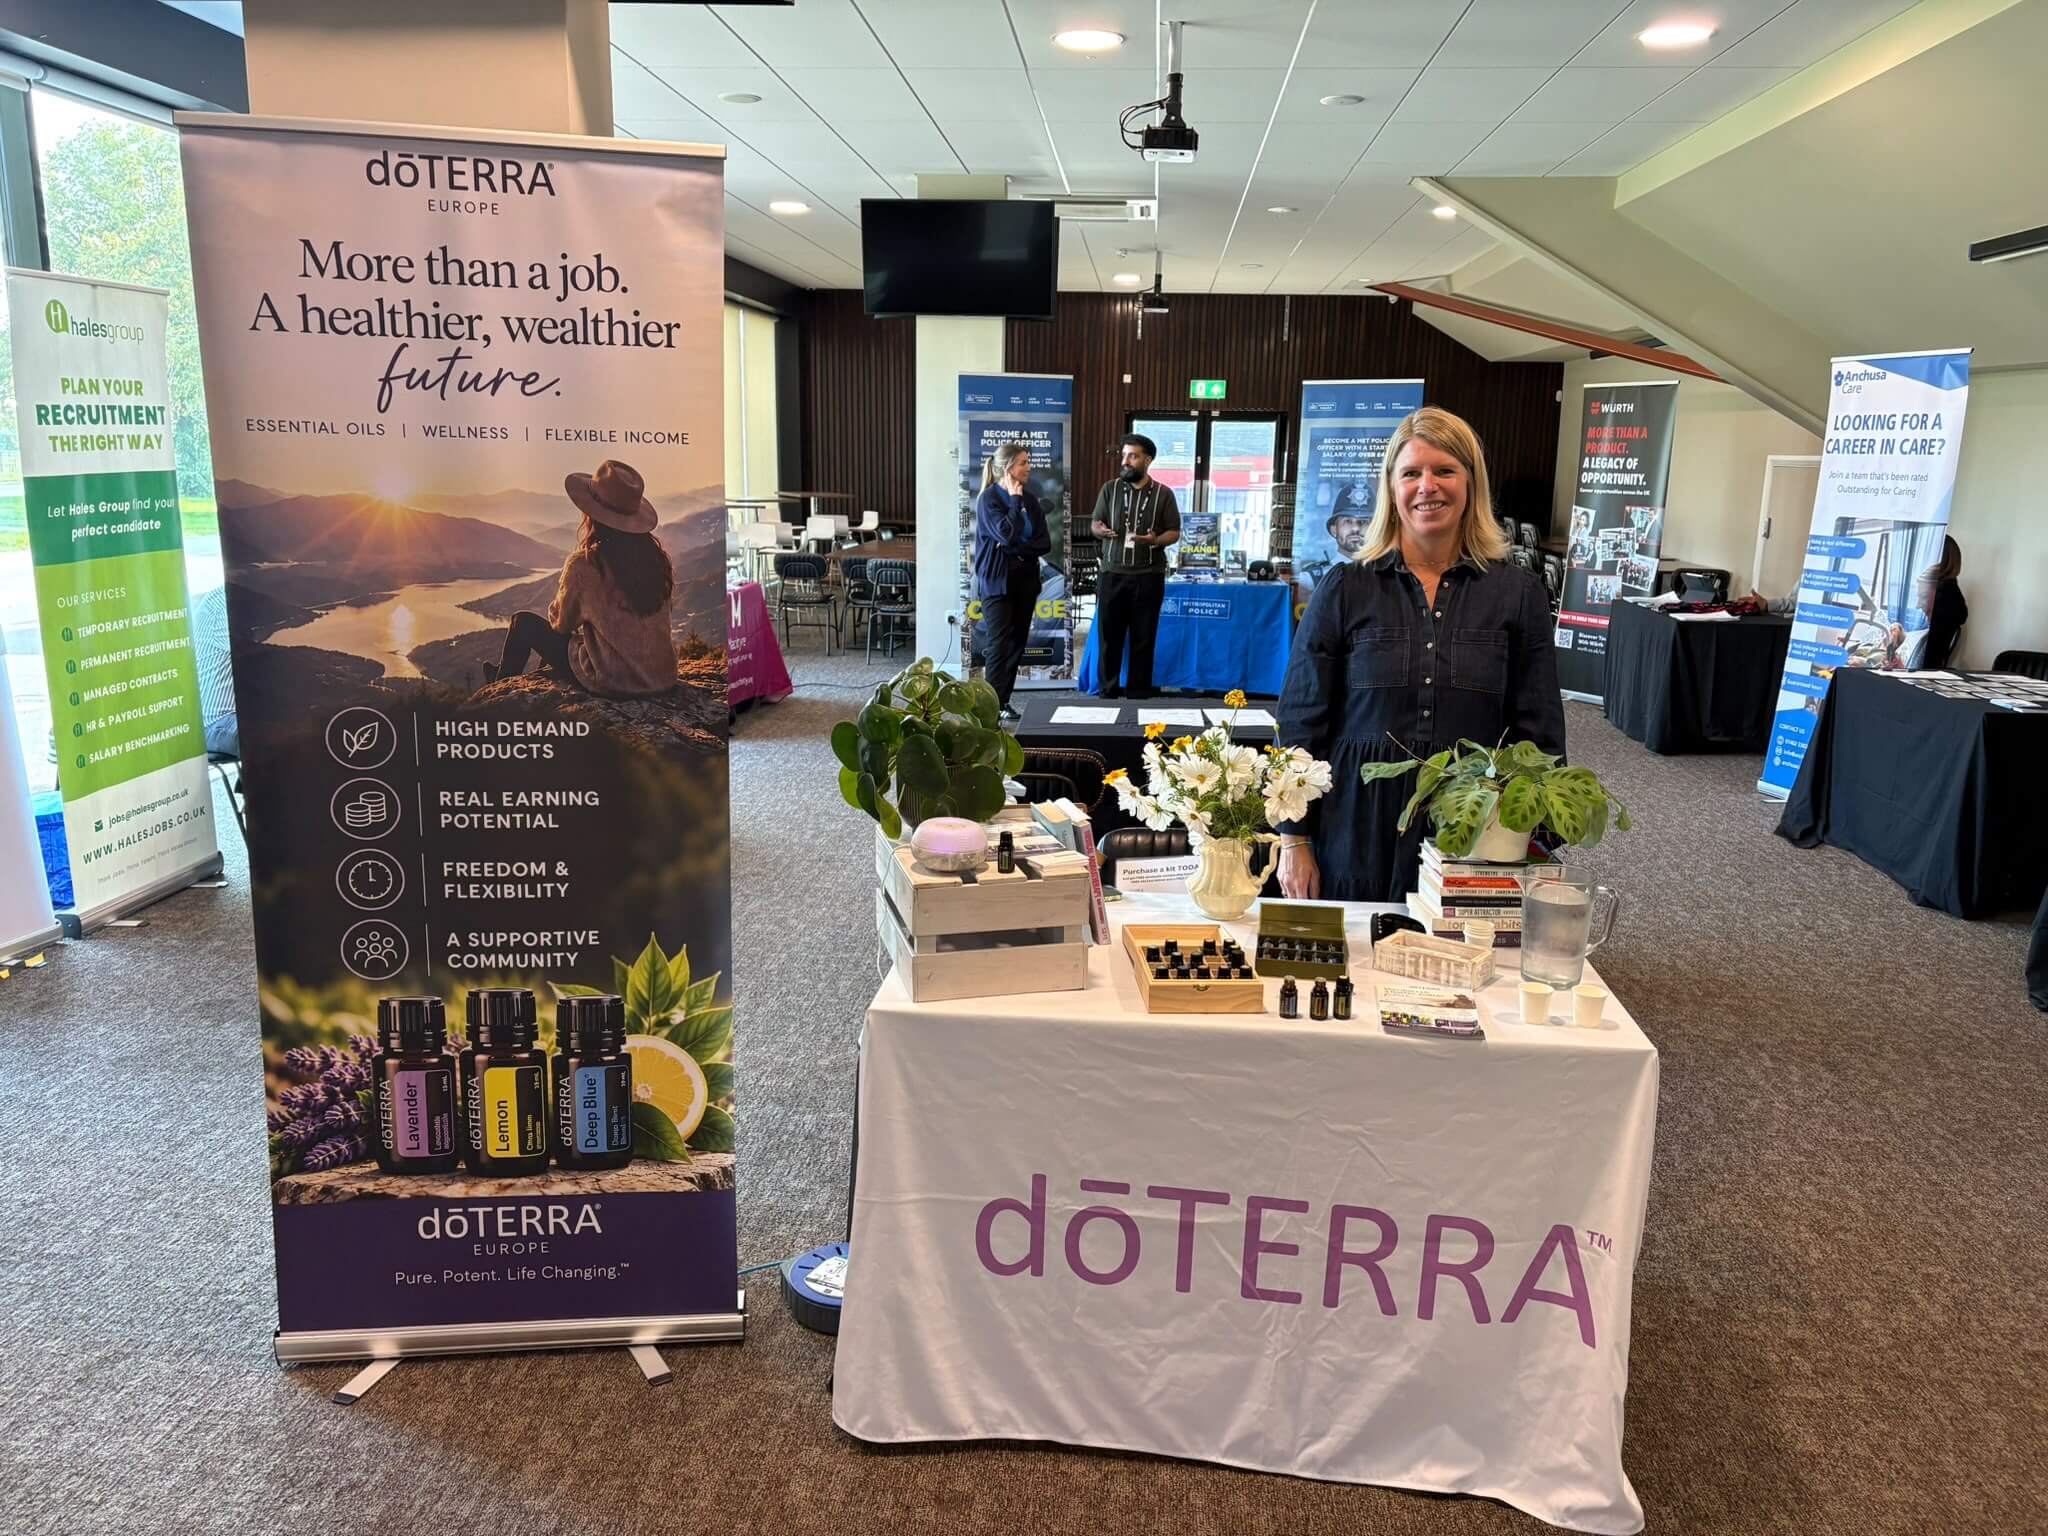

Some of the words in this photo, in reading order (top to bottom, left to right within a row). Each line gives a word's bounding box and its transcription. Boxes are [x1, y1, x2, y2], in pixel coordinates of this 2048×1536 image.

[428, 199, 499, 215] EUROPE
[299, 239, 414, 283] More
[424, 245, 518, 288] than
[528, 261, 549, 290] a
[556, 253, 627, 302] job.
[249, 292, 289, 332] A
[297, 294, 491, 349] healthier,
[501, 307, 680, 348] wealthier
[71, 316, 144, 344] halesgroup
[377, 343, 561, 413] future.
[1844, 370, 1886, 382] Anchusa
[61, 378, 99, 394] PLAN
[103, 379, 143, 396] YOUR
[1842, 383, 1862, 394] Care
[36, 404, 165, 425] RECRUITMENT
[1834, 414, 1896, 430] LOOKING
[1901, 414, 1928, 430] FOR
[1931, 413, 1942, 430] A
[246, 419, 339, 434] ESSENTIAL
[347, 422, 385, 436] OILS
[422, 424, 508, 439] WELLNESS
[545, 428, 617, 442] FLEXIBLE
[624, 431, 689, 445] INCOME
[984, 430, 1020, 438] BECOME
[1030, 431, 1048, 439] MET
[1587, 427, 1614, 438] MORE
[1616, 427, 1639, 439] THAN
[1640, 427, 1648, 439] A
[49, 435, 77, 452] THE
[80, 435, 124, 451] RIGHT
[127, 434, 162, 450] WAY
[1014, 439, 1051, 447] OFFICER
[1585, 442, 1628, 454] PRODUCT.
[1825, 438, 1876, 455] CAREER
[1880, 439, 1896, 455] IN
[1900, 439, 1946, 455] CARE?
[1582, 457, 1589, 468] A
[1591, 457, 1625, 469] LEGACY
[1626, 458, 1638, 469] OF
[1581, 472, 1646, 485] OPPORTUNITY.
[1829, 471, 1844, 479] Join
[1851, 472, 1868, 480] team
[1870, 472, 1888, 480] that's
[1890, 472, 1908, 481] been
[1911, 473, 1928, 481] rated
[1837, 485, 1879, 496] Outstanding
[1881, 486, 1891, 495] for
[1893, 487, 1916, 498] Caring
[47, 506, 65, 518] Let
[69, 503, 95, 515] Hales
[99, 501, 130, 514] Group
[132, 498, 150, 509] find
[72, 523, 107, 542] perfect
[111, 520, 161, 533] candidate
[57, 597, 79, 608] OUR
[81, 587, 126, 605] SERVICES
[1183, 601, 1225, 609] METROPOLITAN
[78, 618, 129, 639] TEMPORARY
[132, 608, 188, 627] RECRUITMENT
[80, 649, 132, 670] PERMANENT
[135, 637, 190, 657] RECRUITMENT
[83, 683, 127, 702] MANAGED
[129, 668, 178, 689] CONTRACTS
[86, 721, 97, 733] HR
[99, 717, 106, 728] &
[108, 708, 147, 726] PAYROLL
[149, 696, 184, 714] SUPPORT
[435, 721, 488, 737] HIGH
[497, 721, 590, 737] DEMAND
[89, 742, 123, 764] SALARY
[125, 724, 189, 752] BENCHMARKING
[437, 743, 554, 759] PRODUCTS
[439, 792, 494, 807] REAL
[502, 791, 600, 807] EARNING
[108, 789, 189, 829] jobs@halesgroup.co.uk
[441, 814, 559, 829] POTENTIAL
[83, 806, 206, 865] WWW.HALESJOBS.CO.UK
[443, 862, 546, 877] FREEDOM
[555, 861, 569, 877] &
[444, 883, 569, 899] FLEXIBILITY
[447, 933, 460, 948] A
[469, 930, 600, 947] SUPPORTIVE
[448, 952, 578, 968] COMMUNITY
[406, 1082, 420, 1151] Lavender
[496, 1099, 510, 1152] Lemon
[585, 1108, 598, 1149] Deep
[474, 1242, 549, 1255] EUROPE
[395, 1272, 436, 1285] Pure.
[443, 1269, 500, 1282] Potent.
[508, 1267, 536, 1280] Life
